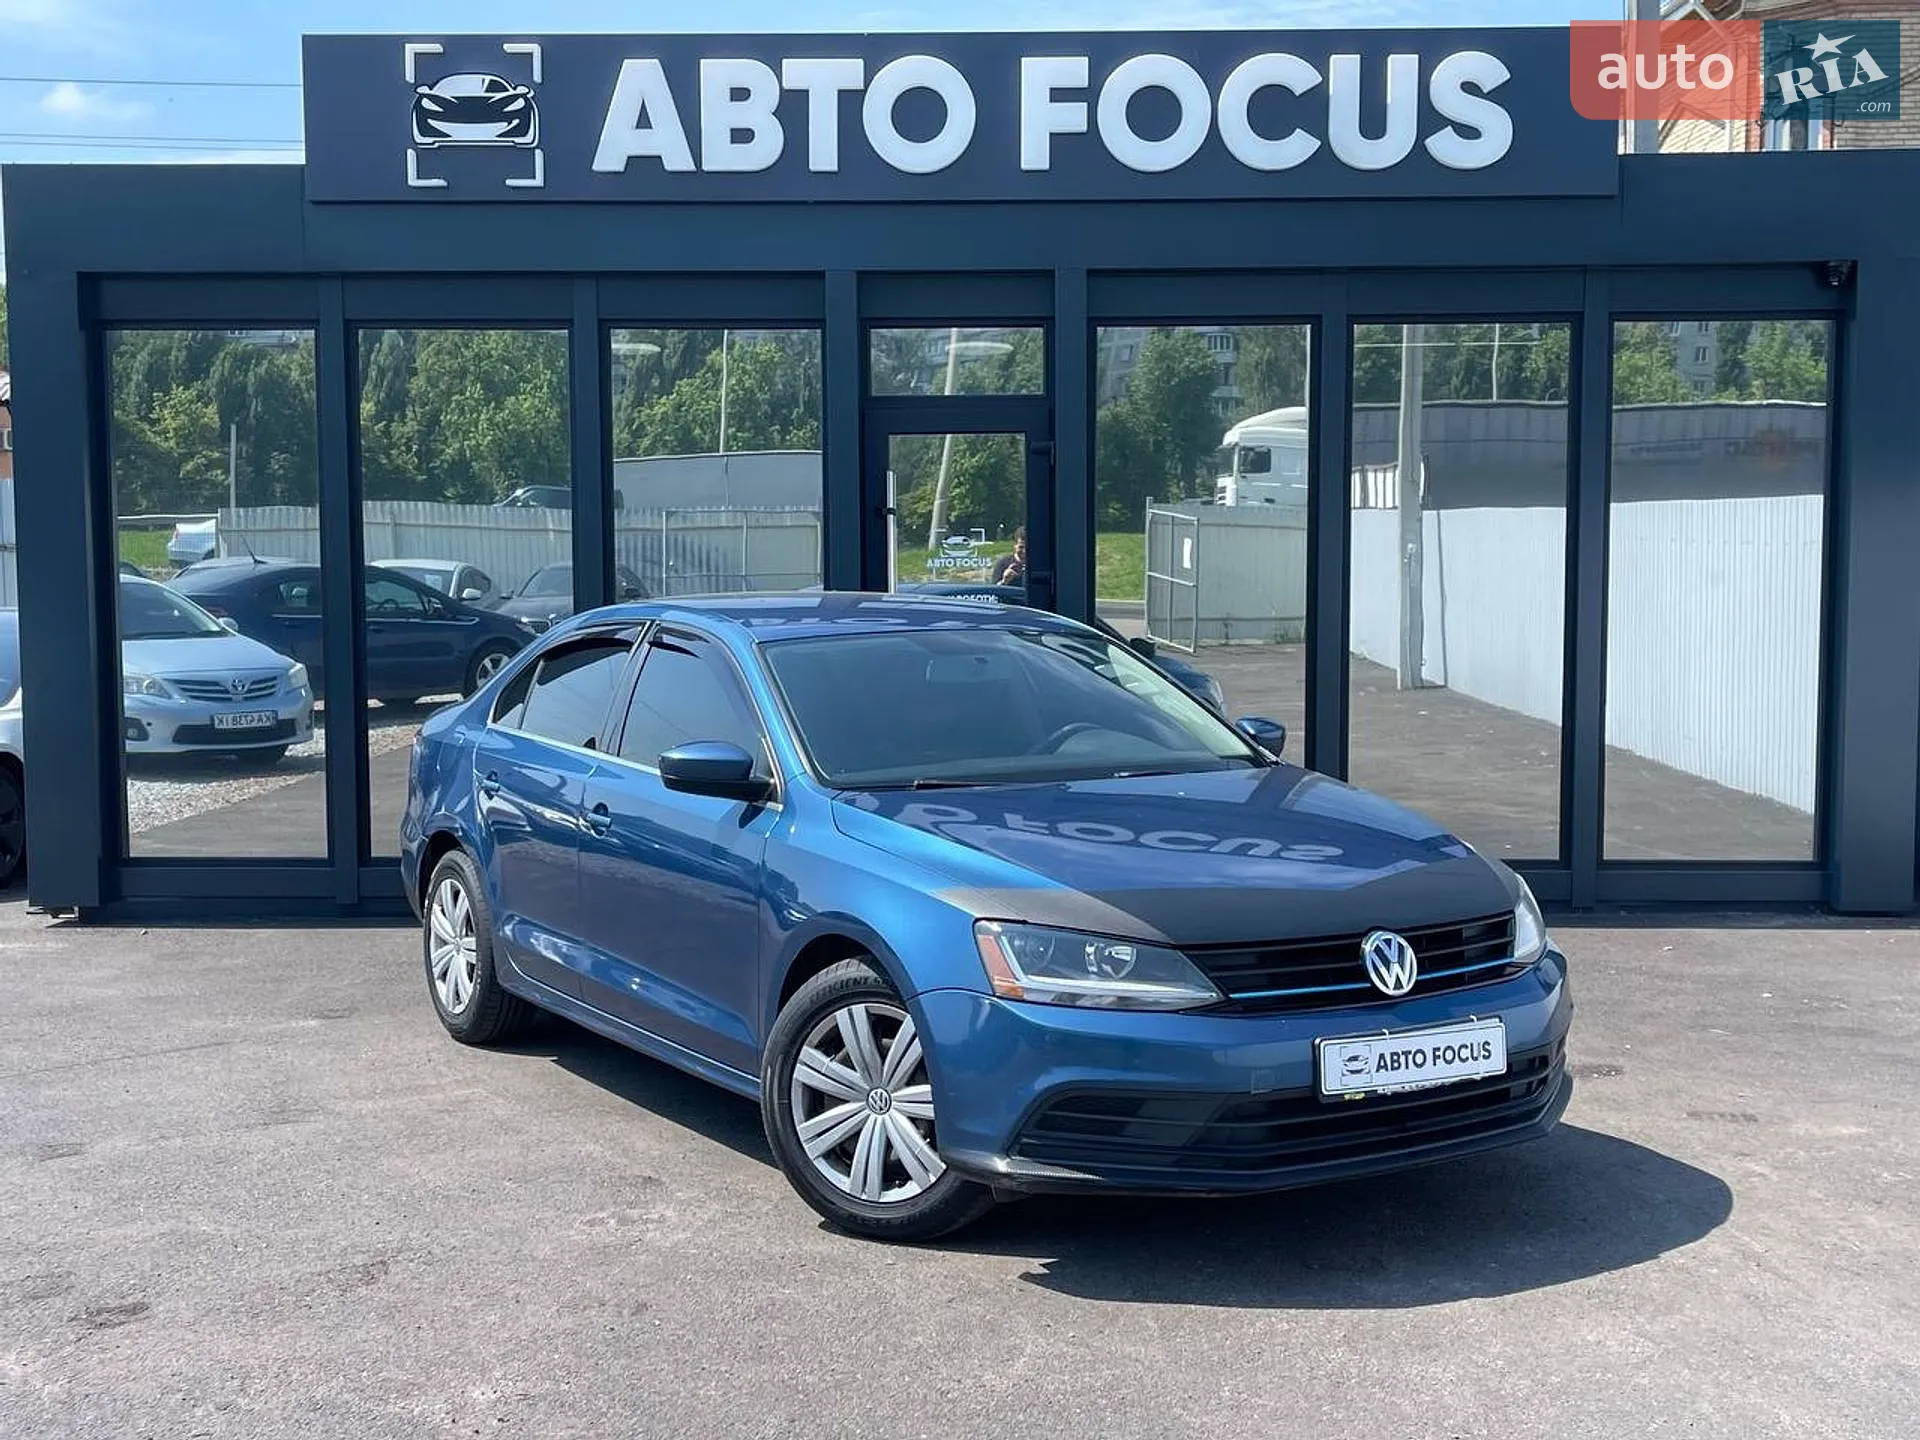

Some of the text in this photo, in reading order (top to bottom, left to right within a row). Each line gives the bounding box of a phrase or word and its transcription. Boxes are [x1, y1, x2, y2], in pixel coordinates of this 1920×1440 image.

[591, 50, 1514, 174] АВТО FOCUS
[956, 557, 992, 567] FOCUS
[1375, 1040, 1492, 1073] АВТО FOCUS
